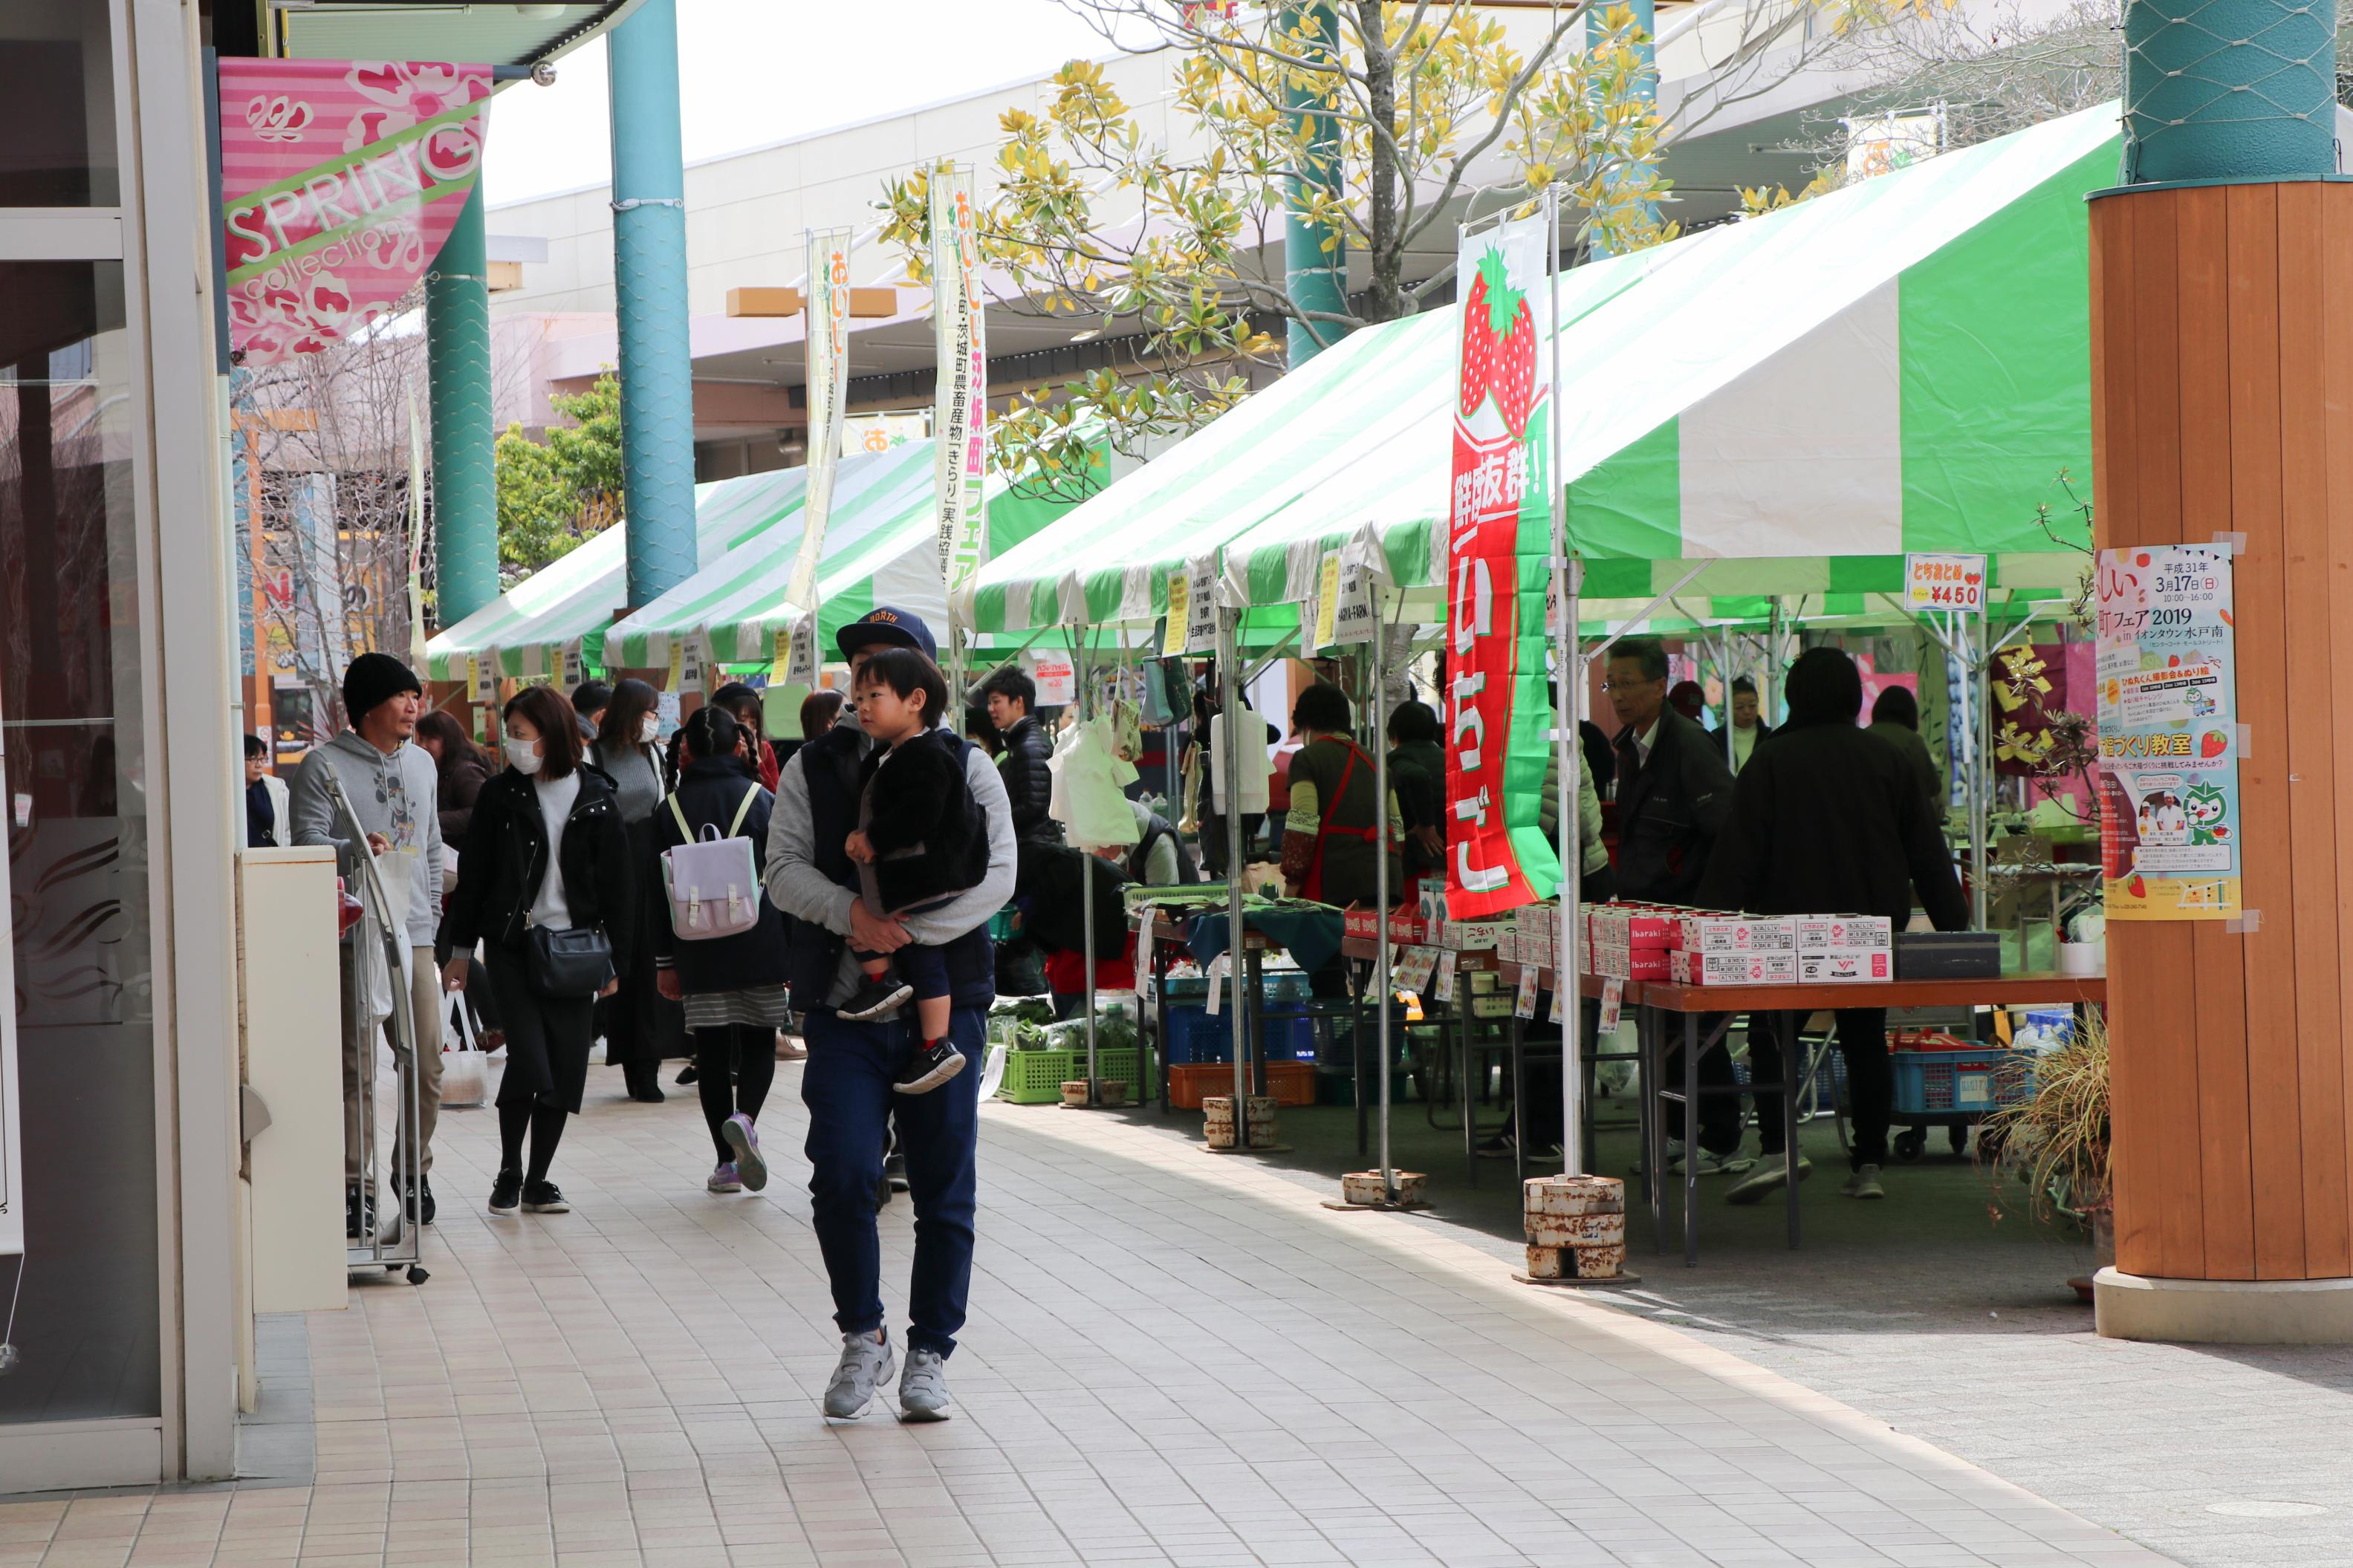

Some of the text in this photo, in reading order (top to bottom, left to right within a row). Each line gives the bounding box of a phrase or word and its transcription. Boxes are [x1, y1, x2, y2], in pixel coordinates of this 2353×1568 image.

[227, 123, 480, 264] SPRING
[245, 221, 405, 300] collection
[938, 264, 970, 591] 城町・茨城町農畜産物「きらり」実践協議
[1914, 562, 1962, 581] とちおとめ
[2164, 562, 2209, 574] 平成31年
[2155, 575, 2219, 593] 3月17日(日)
[1932, 586, 1977, 604] ¥450
[869, 610, 898, 623] NORTH
[2152, 608, 2193, 625] 2019
[2135, 625, 2224, 640] イオンタウン水戸南
[1467, 926, 1495, 938] いちご
[1632, 930, 1661, 938] Ibaraki
[1631, 960, 1661, 969] Ibaraki
